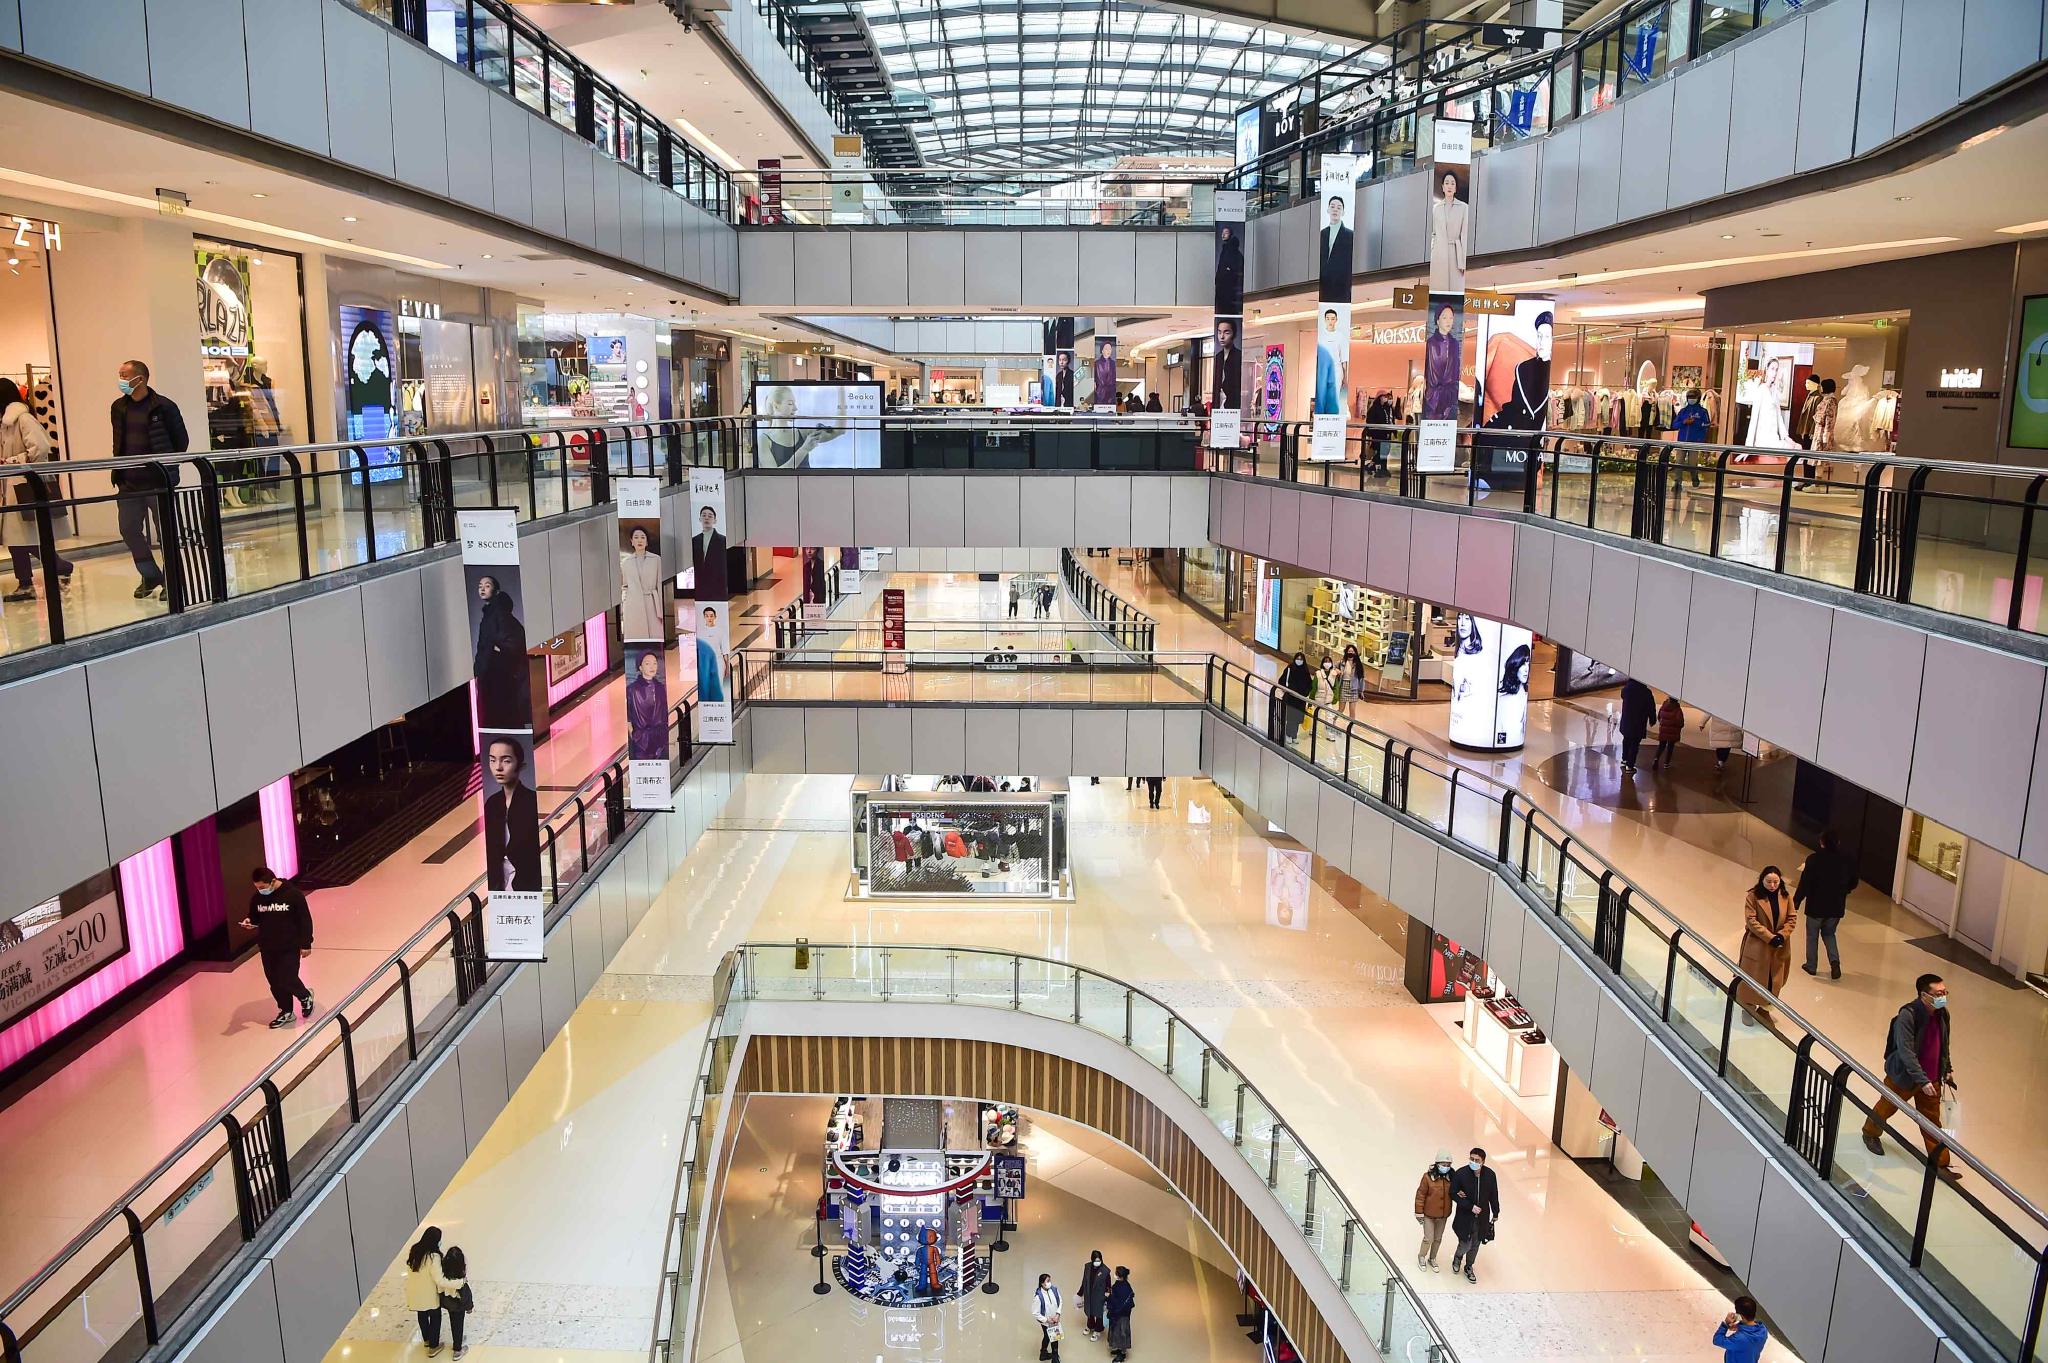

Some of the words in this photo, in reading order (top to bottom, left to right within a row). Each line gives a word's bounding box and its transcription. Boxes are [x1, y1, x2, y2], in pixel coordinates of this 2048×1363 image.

[1275, 115, 1295, 137] BOY
[1402, 293, 1414, 304] L2
[477, 540, 515, 549] 8scenes
[1270, 567, 1280, 575] L1
